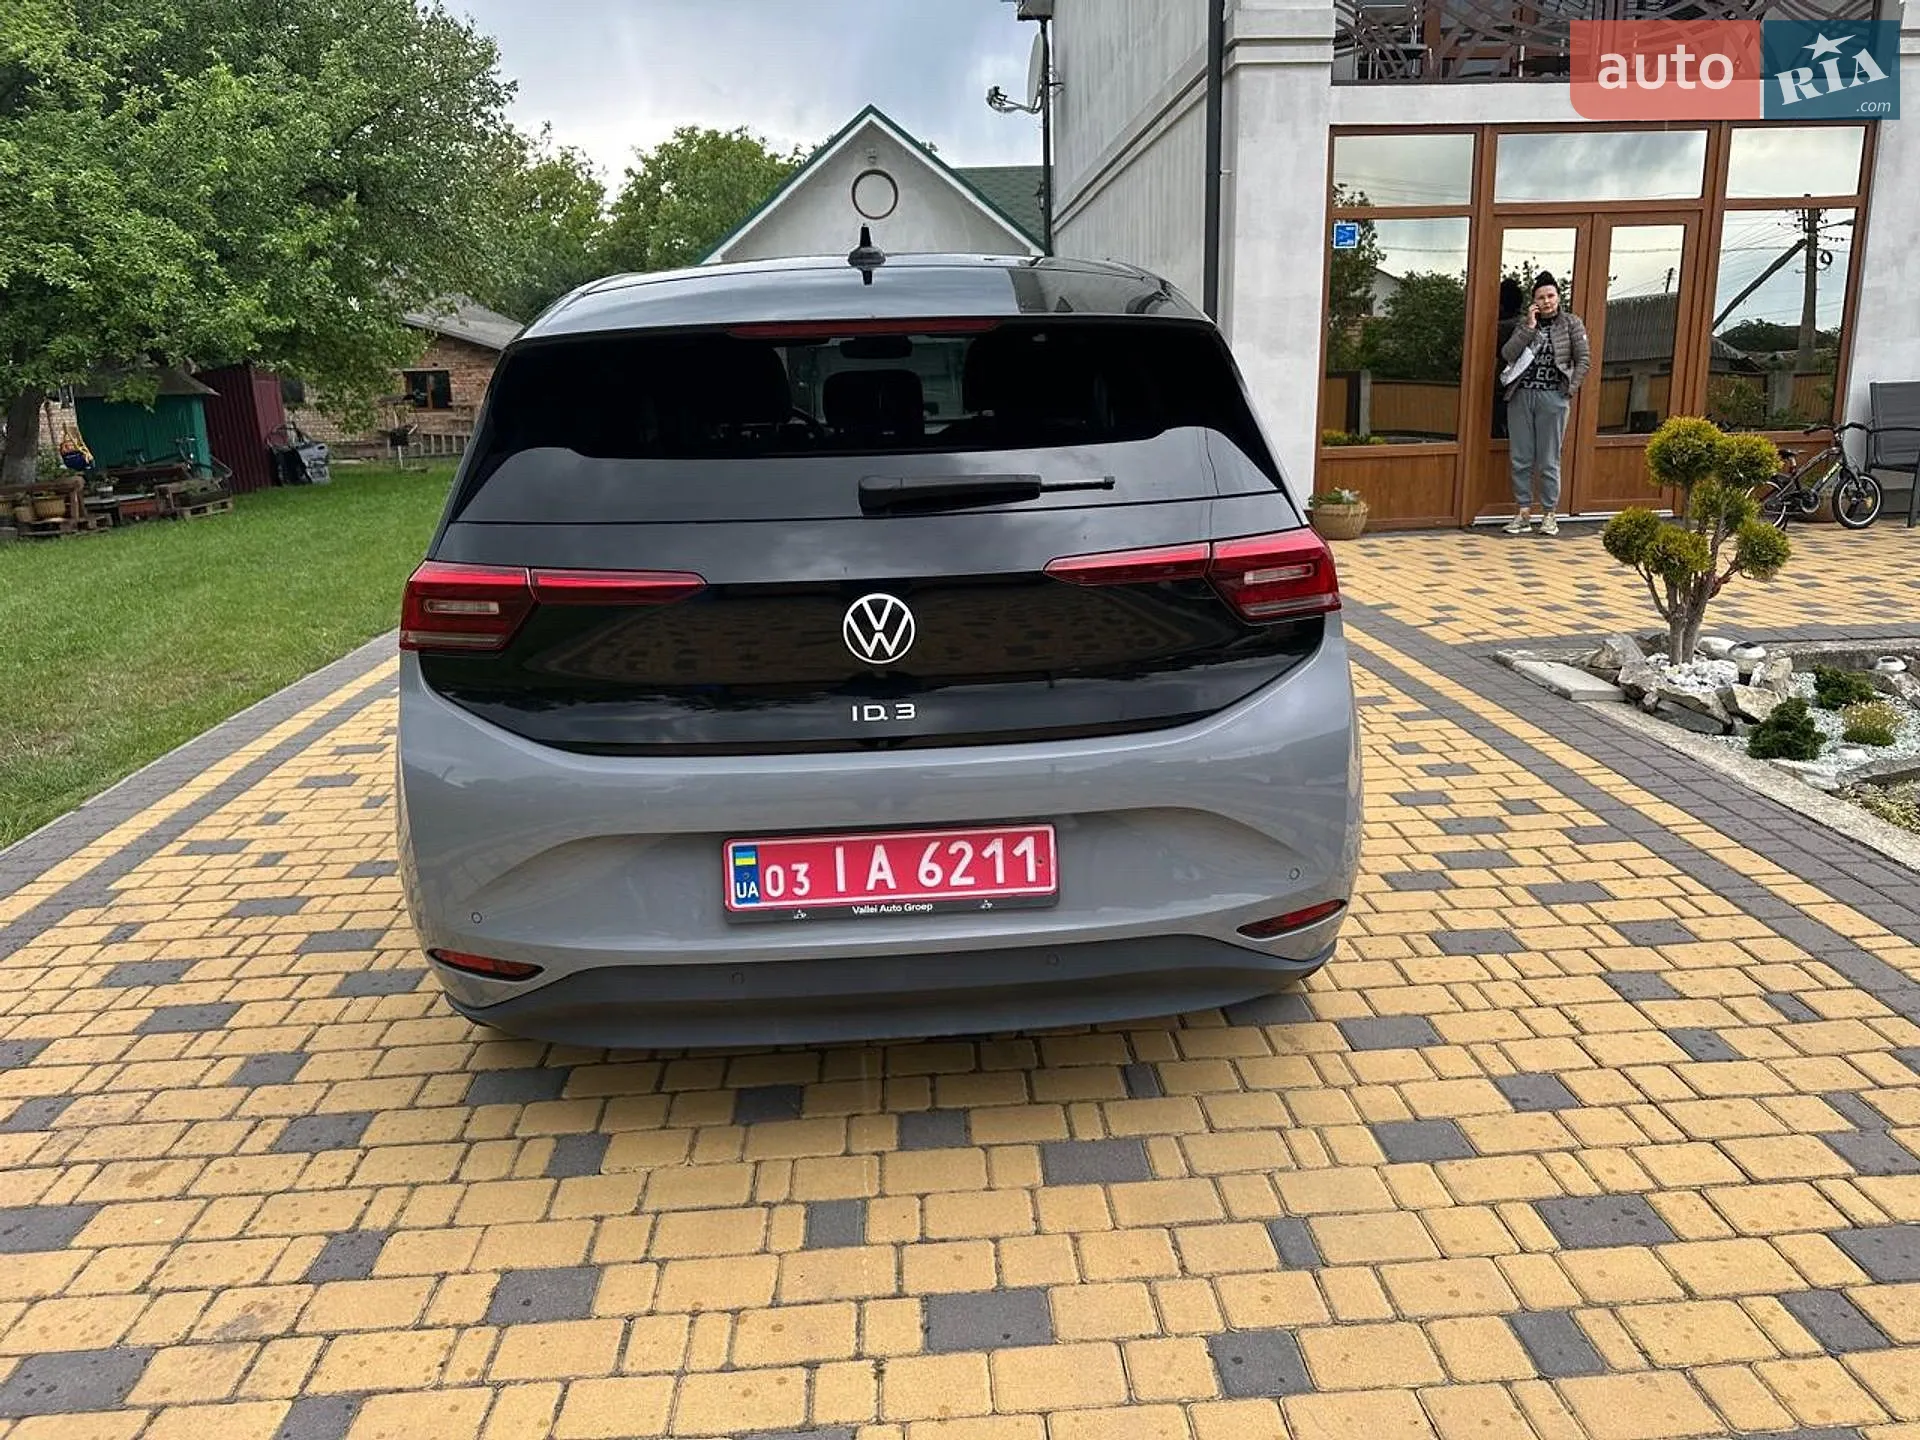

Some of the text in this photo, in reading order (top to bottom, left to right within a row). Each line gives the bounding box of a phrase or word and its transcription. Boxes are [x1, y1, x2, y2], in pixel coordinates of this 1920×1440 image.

[765, 862, 811, 898] 03
[917, 836, 1037, 888] 6211
[736, 881, 759, 898] UA
[879, 904, 903, 913] Auto
[903, 903, 933, 912] Groep
